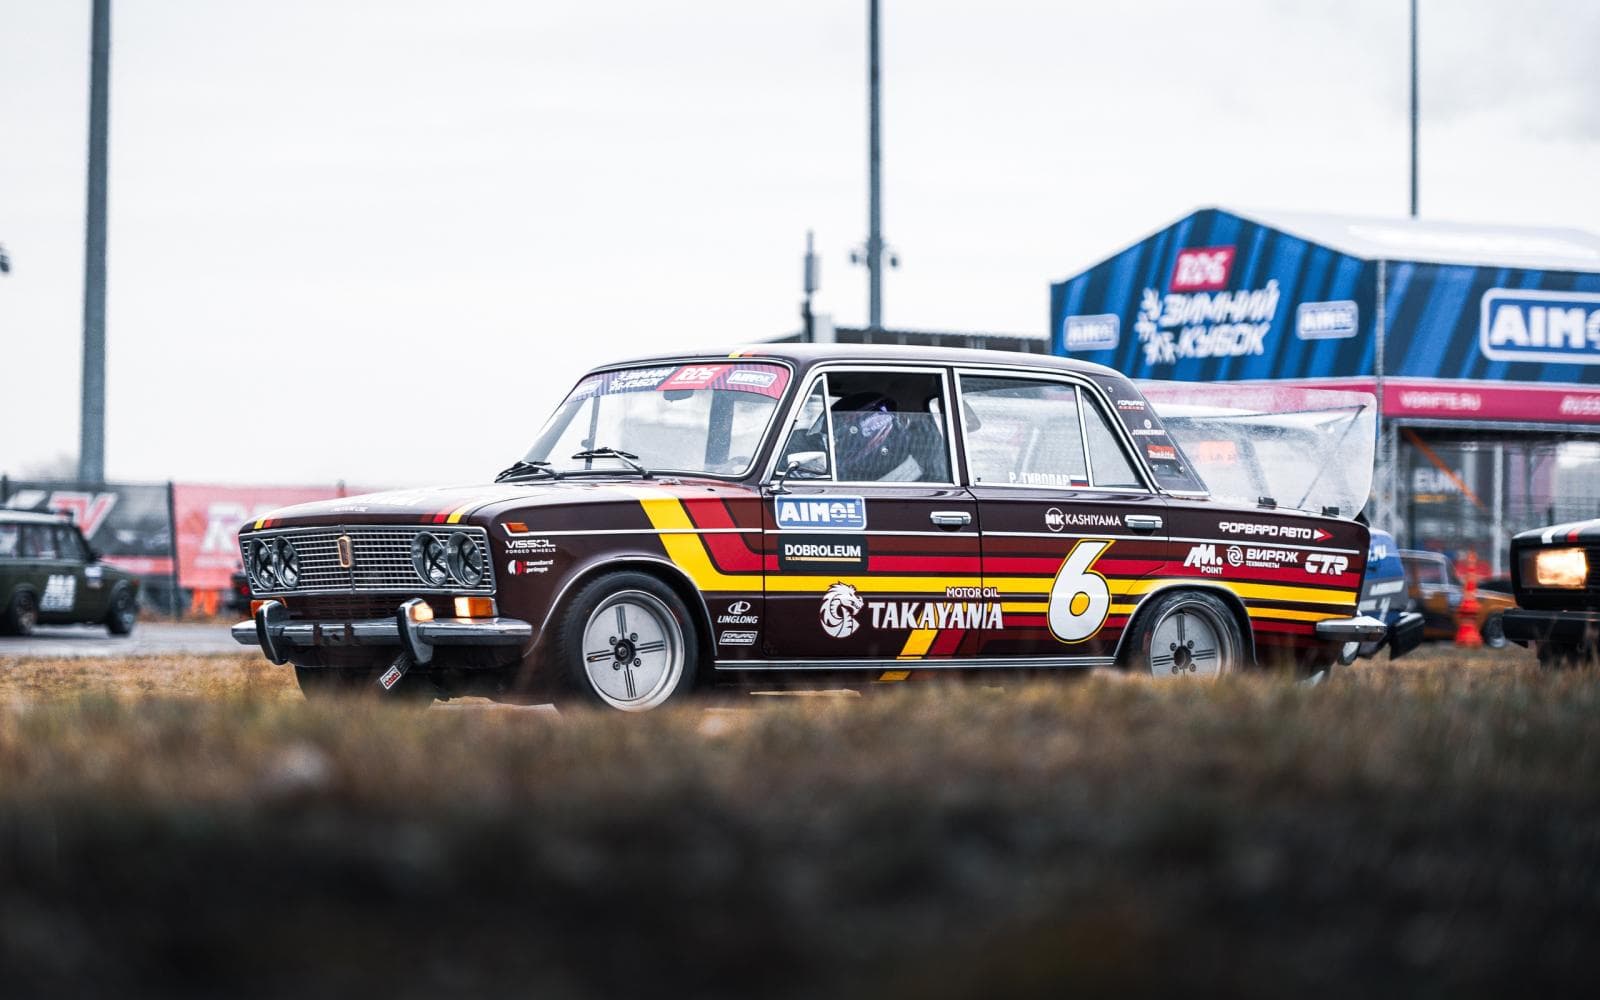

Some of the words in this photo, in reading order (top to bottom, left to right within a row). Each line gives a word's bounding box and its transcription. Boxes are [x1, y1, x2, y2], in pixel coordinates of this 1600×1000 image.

[780, 501, 862, 523] AIMOL
[1065, 513, 1122, 526] KASHIYAMA
[1219, 521, 1279, 536] ФОРВАРД
[1279, 526, 1312, 539] АВТО
[505, 540, 556, 548] VISSOL
[784, 544, 862, 557] DOBROLEUM
[1246, 548, 1299, 563] ВИРАЖ
[1201, 567, 1224, 575] POINT
[1304, 553, 1349, 575] CTR
[946, 587, 982, 598] MOTOR
[983, 588, 1000, 597] OIL
[1048, 538, 1115, 643] 6
[717, 615, 759, 624] LINGLONG
[868, 602, 1004, 629] TAKAYAMA
